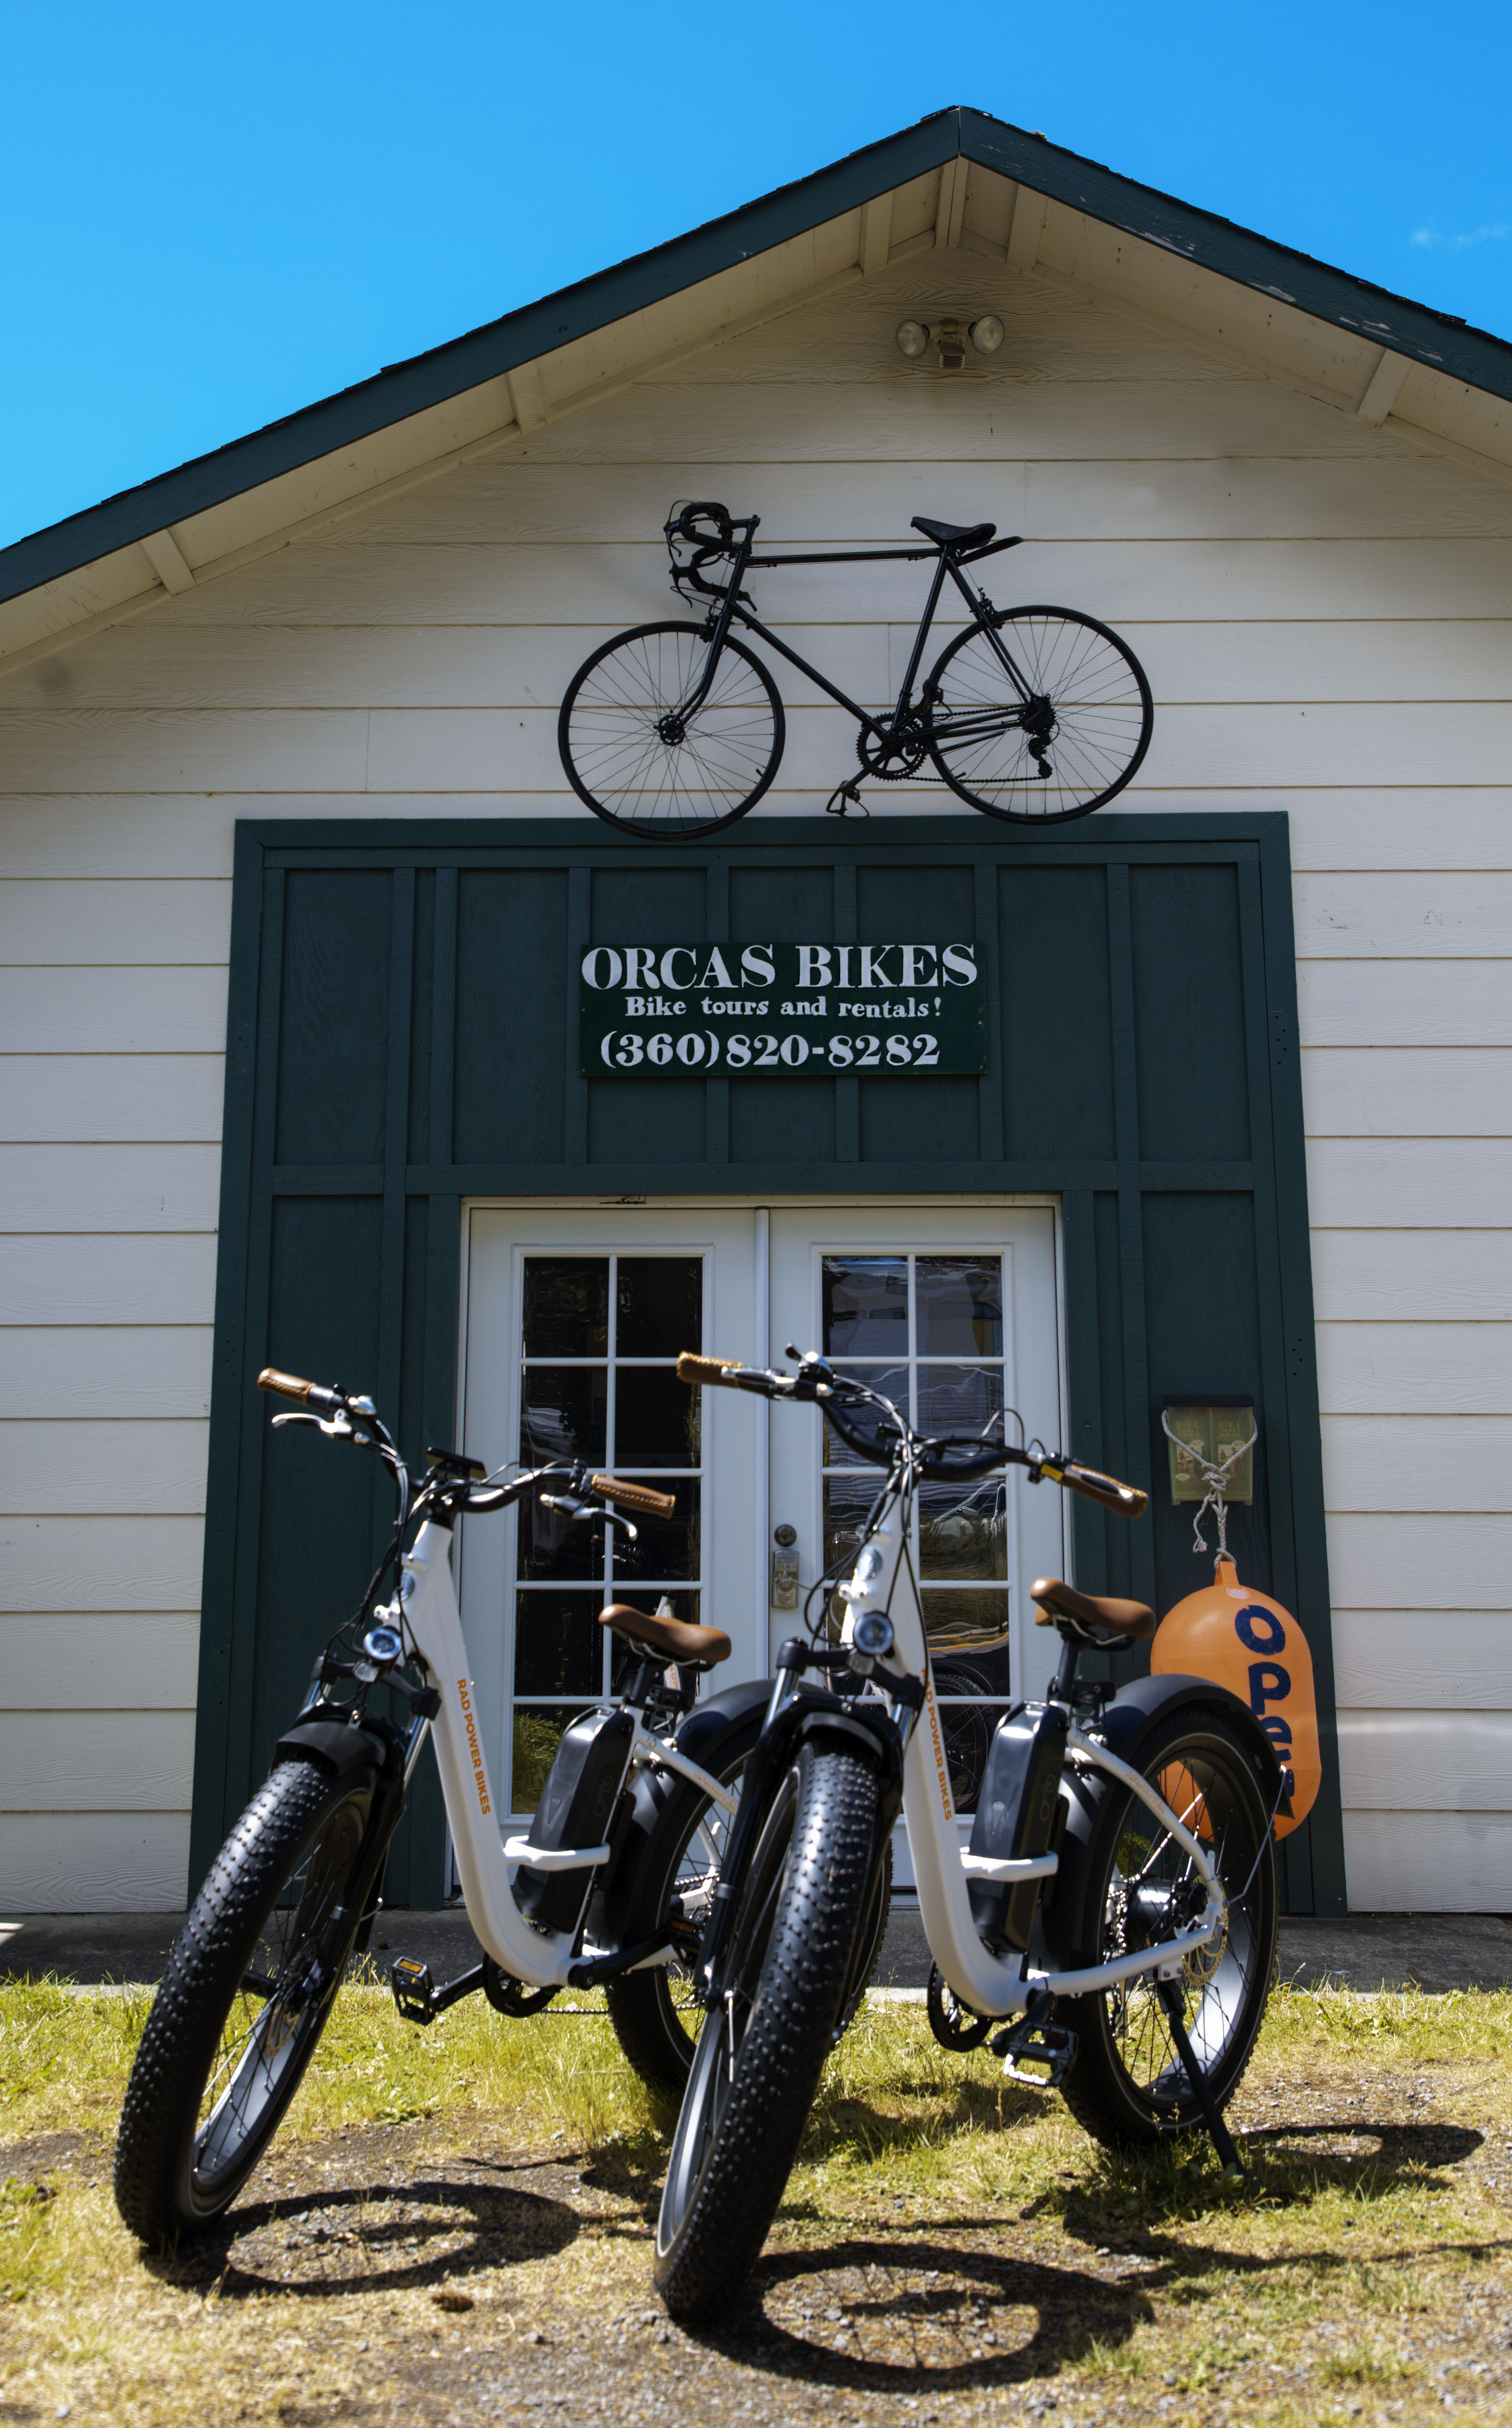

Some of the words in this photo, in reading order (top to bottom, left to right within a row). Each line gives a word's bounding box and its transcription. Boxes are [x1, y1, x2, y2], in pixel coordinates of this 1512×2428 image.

[582, 944, 776, 990] ORCAS
[795, 944, 978, 988] BIKES
[625, 996, 687, 1016] Bike
[701, 996, 770, 1015] tours
[780, 995, 828, 1016] and
[838, 997, 941, 1018] rentals!
[601, 1030, 940, 1068] (360)820-8282
[1176, 1420, 1200, 1429] BIKE
[1219, 1420, 1241, 1429] BIKE
[457, 1678, 470, 1711] RAD
[464, 1713, 482, 1770] POWER
[475, 1770, 491, 1815] BIKES
[927, 1705, 943, 1769] POWER
[938, 1770, 952, 1821] BIKES
